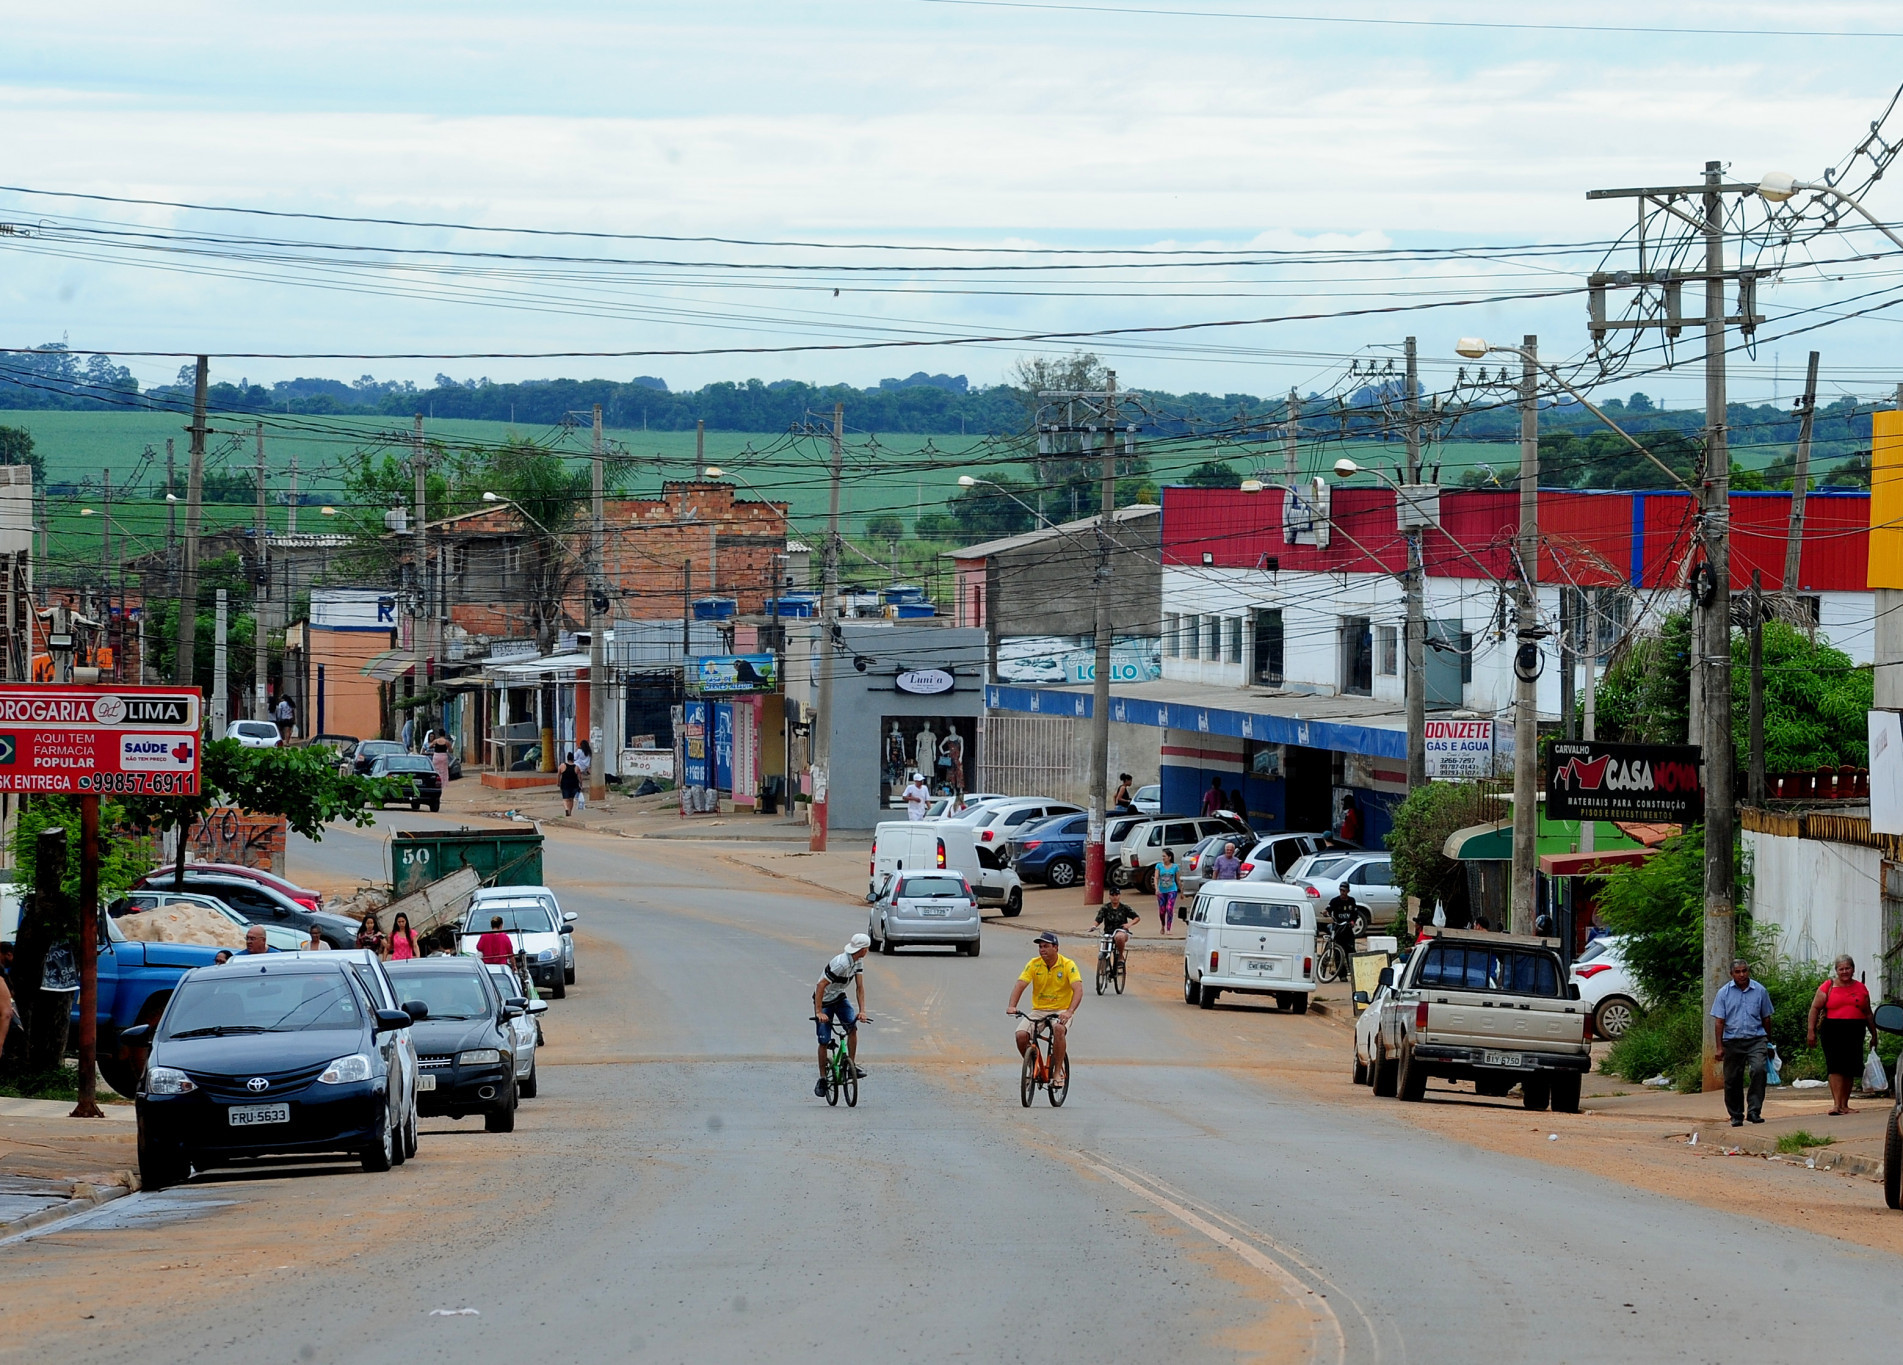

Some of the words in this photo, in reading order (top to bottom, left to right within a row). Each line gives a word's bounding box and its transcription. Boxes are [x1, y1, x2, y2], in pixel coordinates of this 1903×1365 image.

[377, 596, 395, 622] R
[129, 702, 180, 720] LIMA
[1425, 722, 1492, 738] DONIZETE
[34, 733, 65, 744] AQUI
[68, 733, 95, 743] TEM
[1426, 739, 1448, 751] GÁS
[1451, 741, 1458, 751] E
[1460, 739, 1490, 751] ÁGUA
[34, 745, 95, 755] FARMACIA
[124, 741, 168, 753] SAÚDE
[1555, 744, 1590, 755] CARVALHO
[34, 757, 95, 768] POPULAR
[15, 775, 71, 790] ENTREGA
[92, 772, 194, 793] 99857-6911
[1567, 797, 1608, 807] MATERIAIS
[1612, 798, 1632, 808] PARA
[1636, 800, 1686, 811] CONSTRUÇÃO
[1580, 808, 1603, 817] PISOS
[1604, 809, 1609, 817] E
[1610, 810, 1673, 820] REVESTIMENTOS
[402, 848, 430, 865] 50
[1449, 1013, 1562, 1033] FORD
